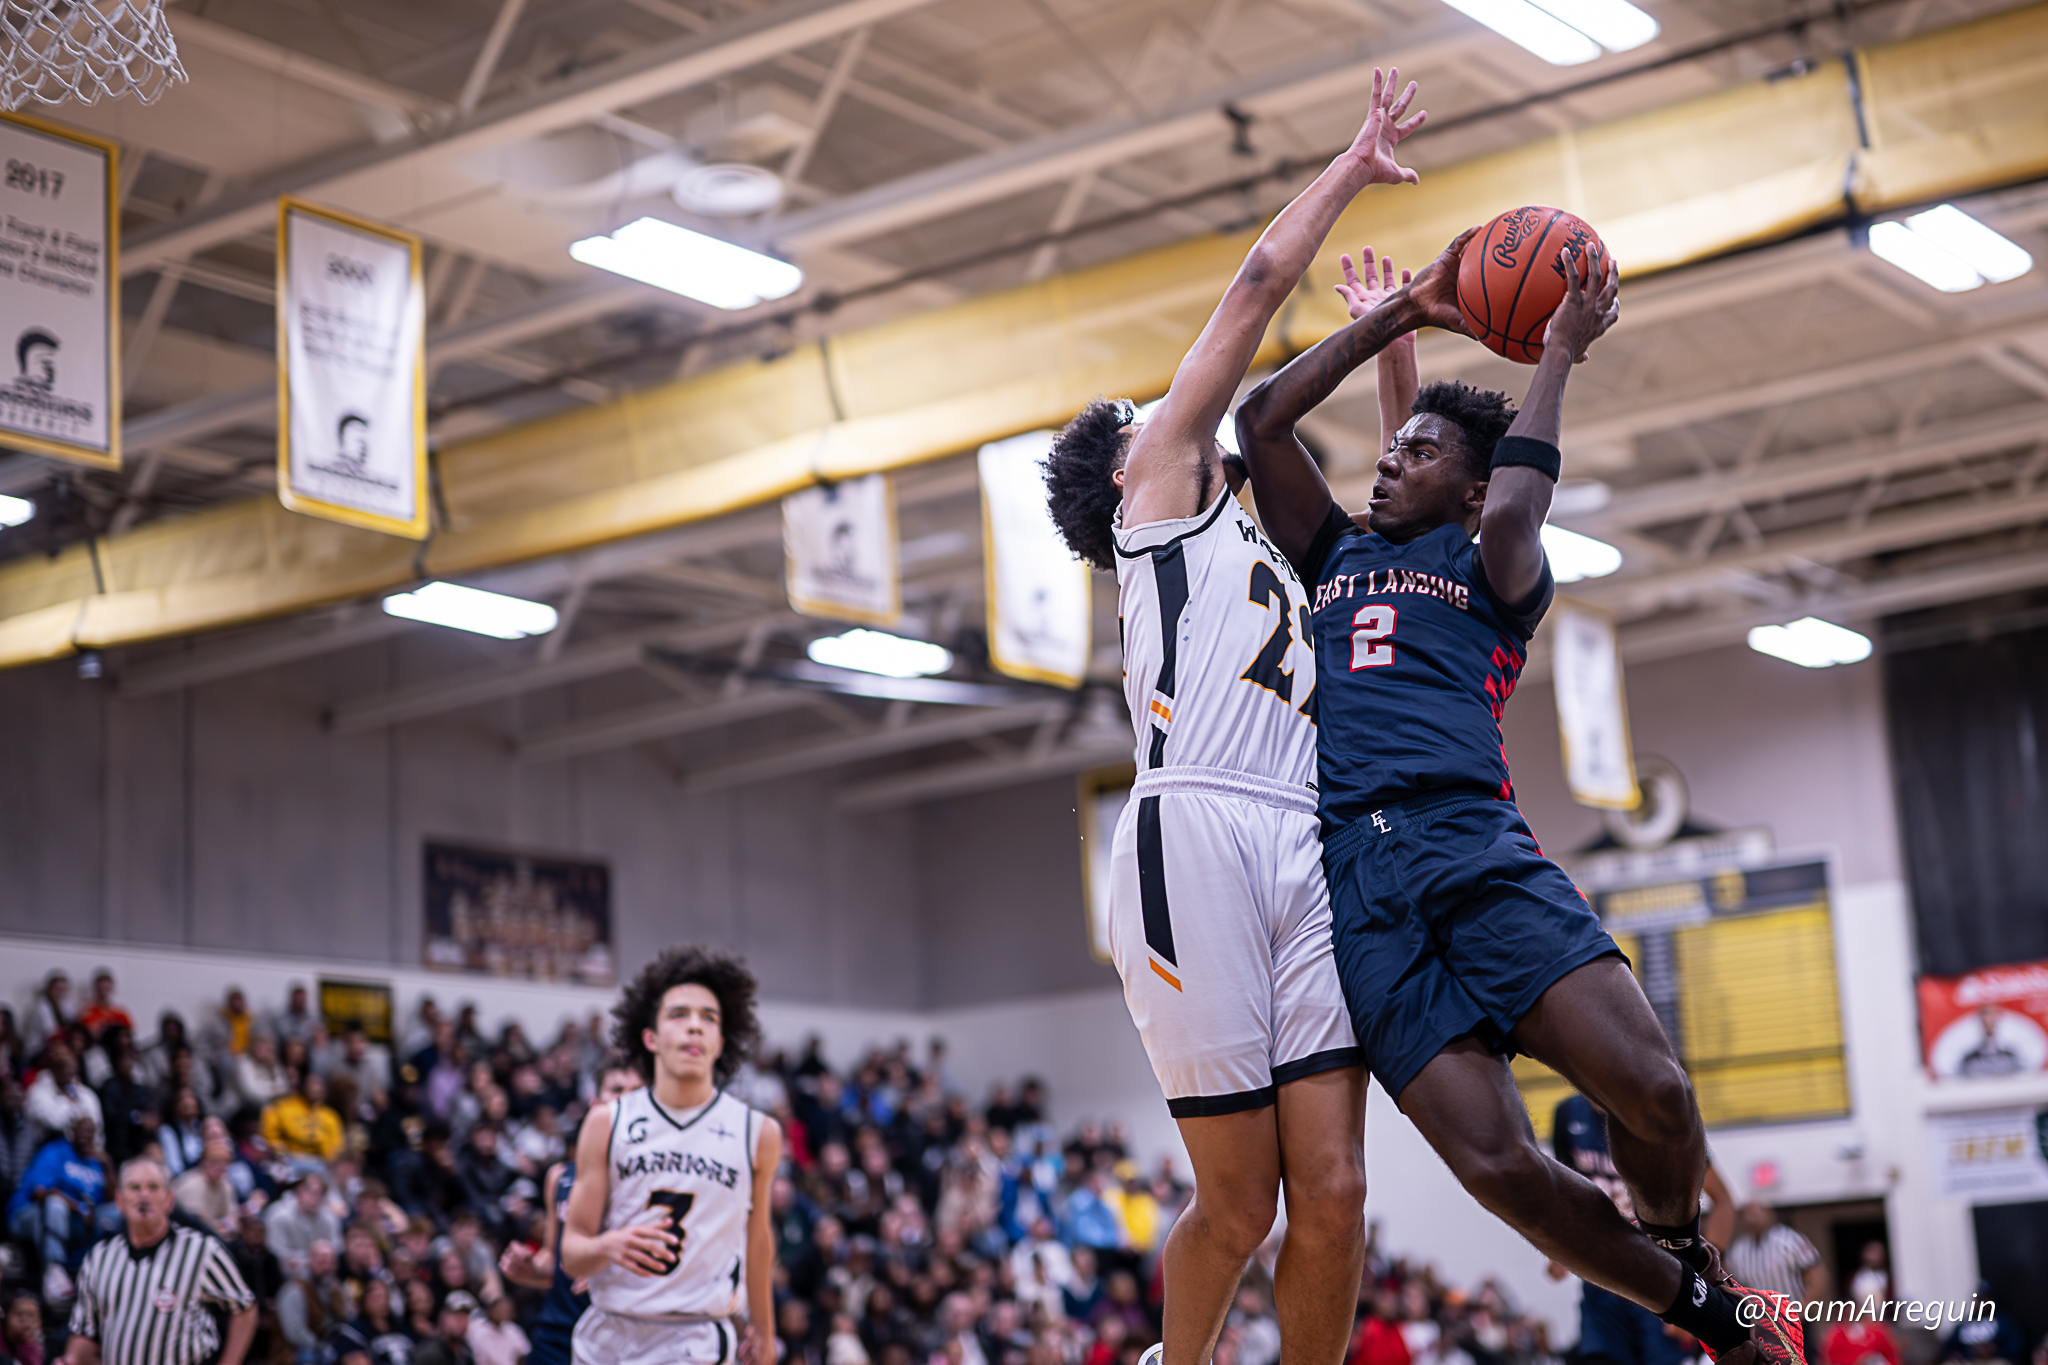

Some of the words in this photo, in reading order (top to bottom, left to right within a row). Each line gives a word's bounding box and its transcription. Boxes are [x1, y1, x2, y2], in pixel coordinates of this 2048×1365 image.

[5, 158, 66, 201] 2017
[1313, 571, 1362, 614] EAST
[1366, 568, 1469, 610] LANSING
[1350, 603, 1398, 673] 2
[616, 1151, 738, 1190] WARRIORS
